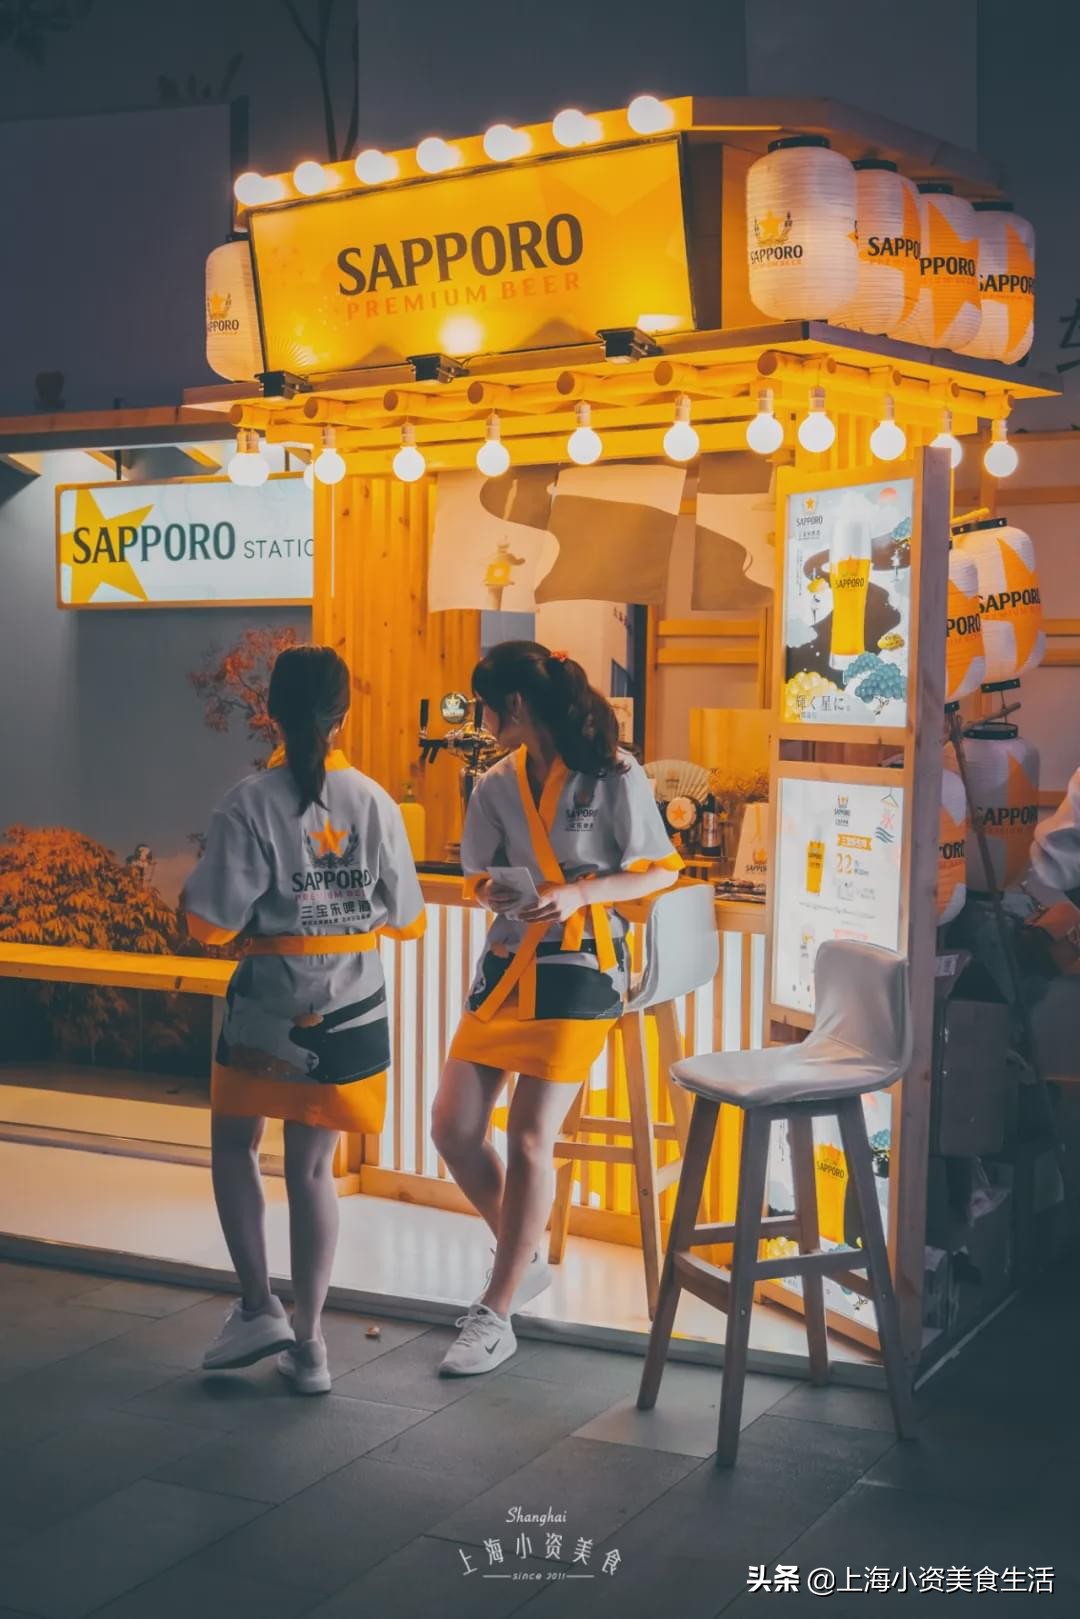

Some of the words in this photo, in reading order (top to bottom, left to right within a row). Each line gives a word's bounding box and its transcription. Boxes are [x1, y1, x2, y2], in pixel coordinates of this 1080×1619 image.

[337, 213, 583, 296] SAPPORO
[347, 284, 487, 320] PREMIUM
[501, 271, 581, 300] BEER
[73, 521, 236, 564] SAPPORO
[292, 869, 372, 892] SAPPORO
[301, 900, 371, 919] 三宝乐啤酒
